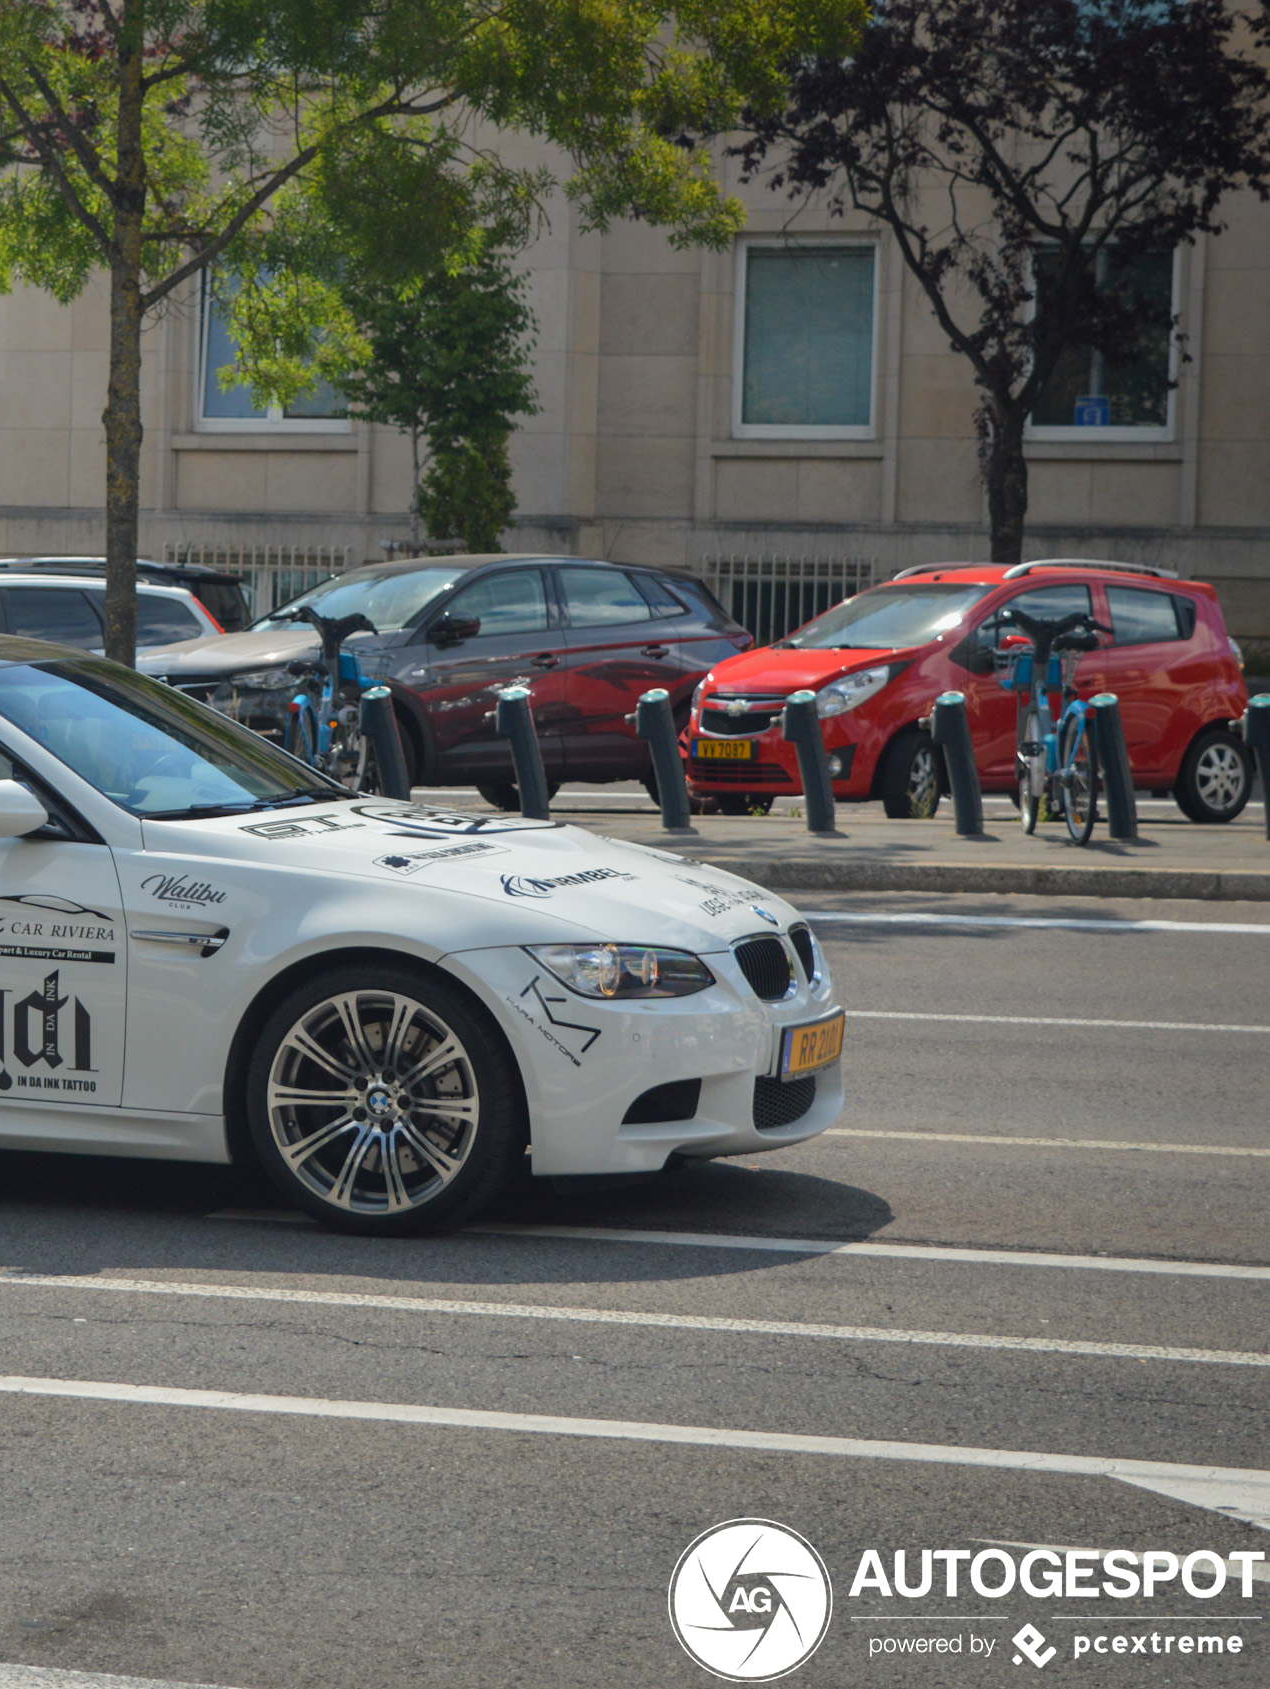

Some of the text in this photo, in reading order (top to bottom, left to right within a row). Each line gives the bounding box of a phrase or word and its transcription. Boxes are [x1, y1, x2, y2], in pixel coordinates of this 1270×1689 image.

[140, 874, 228, 906] Walibu
[168, 902, 191, 910] CLUB
[11, 921, 43, 936] CAR
[50, 924, 115, 941] RIVIERA
[16, 946, 23, 955] &
[24, 947, 51, 959] Luxury
[52, 949, 66, 959] Car
[66, 950, 92, 960] Rental
[46, 979, 56, 1001] INK
[799, 1031, 817, 1066] RR
[17, 1075, 97, 1092] IN DA INK TATTOO
